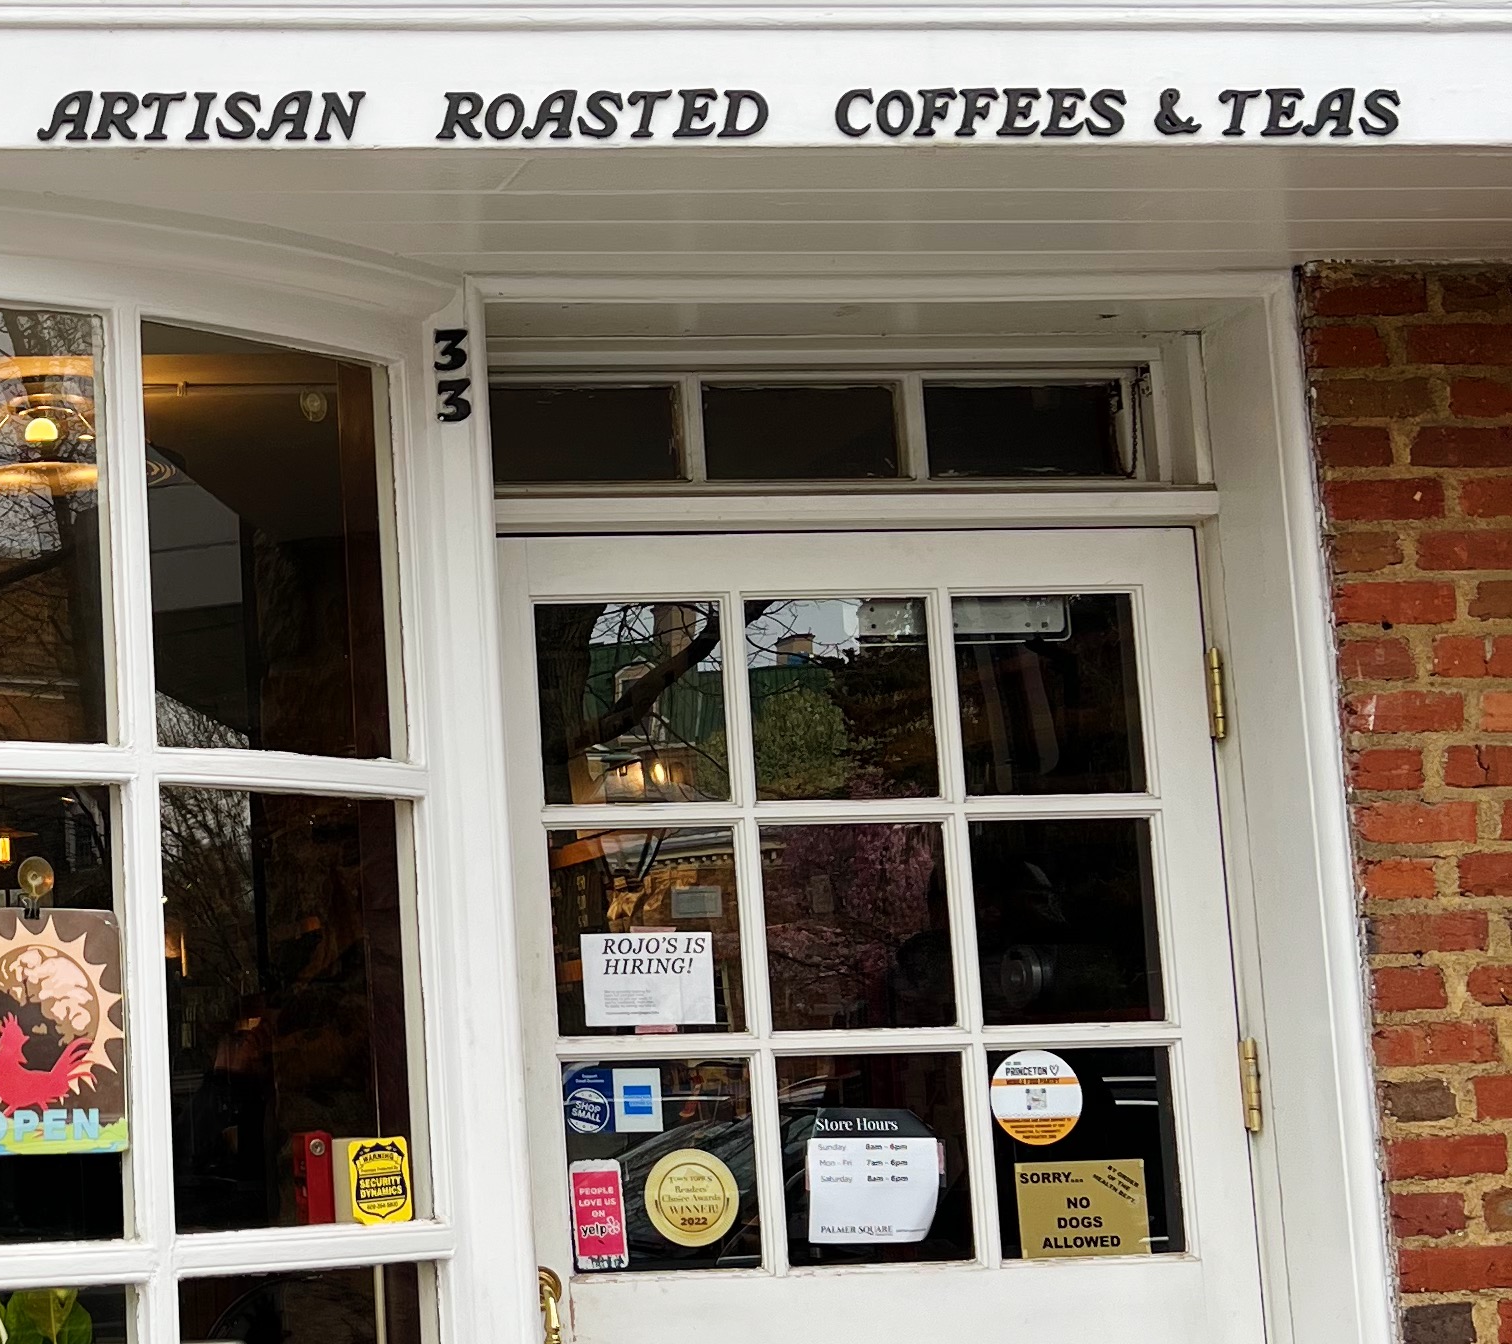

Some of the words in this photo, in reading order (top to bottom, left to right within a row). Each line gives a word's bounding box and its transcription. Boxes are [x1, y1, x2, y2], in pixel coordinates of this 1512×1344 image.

[37, 89, 366, 141] ARTISAN
[437, 87, 769, 140] ROASTED
[835, 86, 1128, 138] COFFEES
[1154, 87, 1202, 136] &
[1219, 86, 1401, 138] TEAS
[602, 937, 678, 955] ROJO'S
[683, 937, 706, 954] IS
[603, 957, 693, 975] HIRING!
[575, 1101, 602, 1114] SHOP
[571, 1107, 601, 1123] SMALL
[815, 1118, 853, 1131] Store
[856, 1117, 899, 1131] Hours
[817, 1143, 847, 1152] Sunday
[362, 1152, 394, 1163] WARNING
[890, 1159, 908, 1167] 6pm
[359, 1175, 402, 1189] SECURITY
[821, 1176, 853, 1184] Saturday
[890, 1175, 909, 1183] 6pm
[1019, 1171, 1084, 1184] SORRY...
[360, 1185, 403, 1199] DYNAMICS
[579, 1186, 614, 1196] PEOPLE
[1117, 1180, 1131, 1192] THE
[578, 1198, 602, 1207] LOVE
[604, 1198, 617, 1206] US
[1066, 1196, 1091, 1209] NO
[591, 1209, 606, 1218] ON
[680, 1216, 708, 1226] 2022
[1057, 1216, 1103, 1229] DOGS
[581, 1223, 607, 1237] yelp
[820, 1225, 856, 1234] PALMER
[858, 1225, 893, 1235] SQUARE
[1042, 1235, 1121, 1249] ALLOWED
